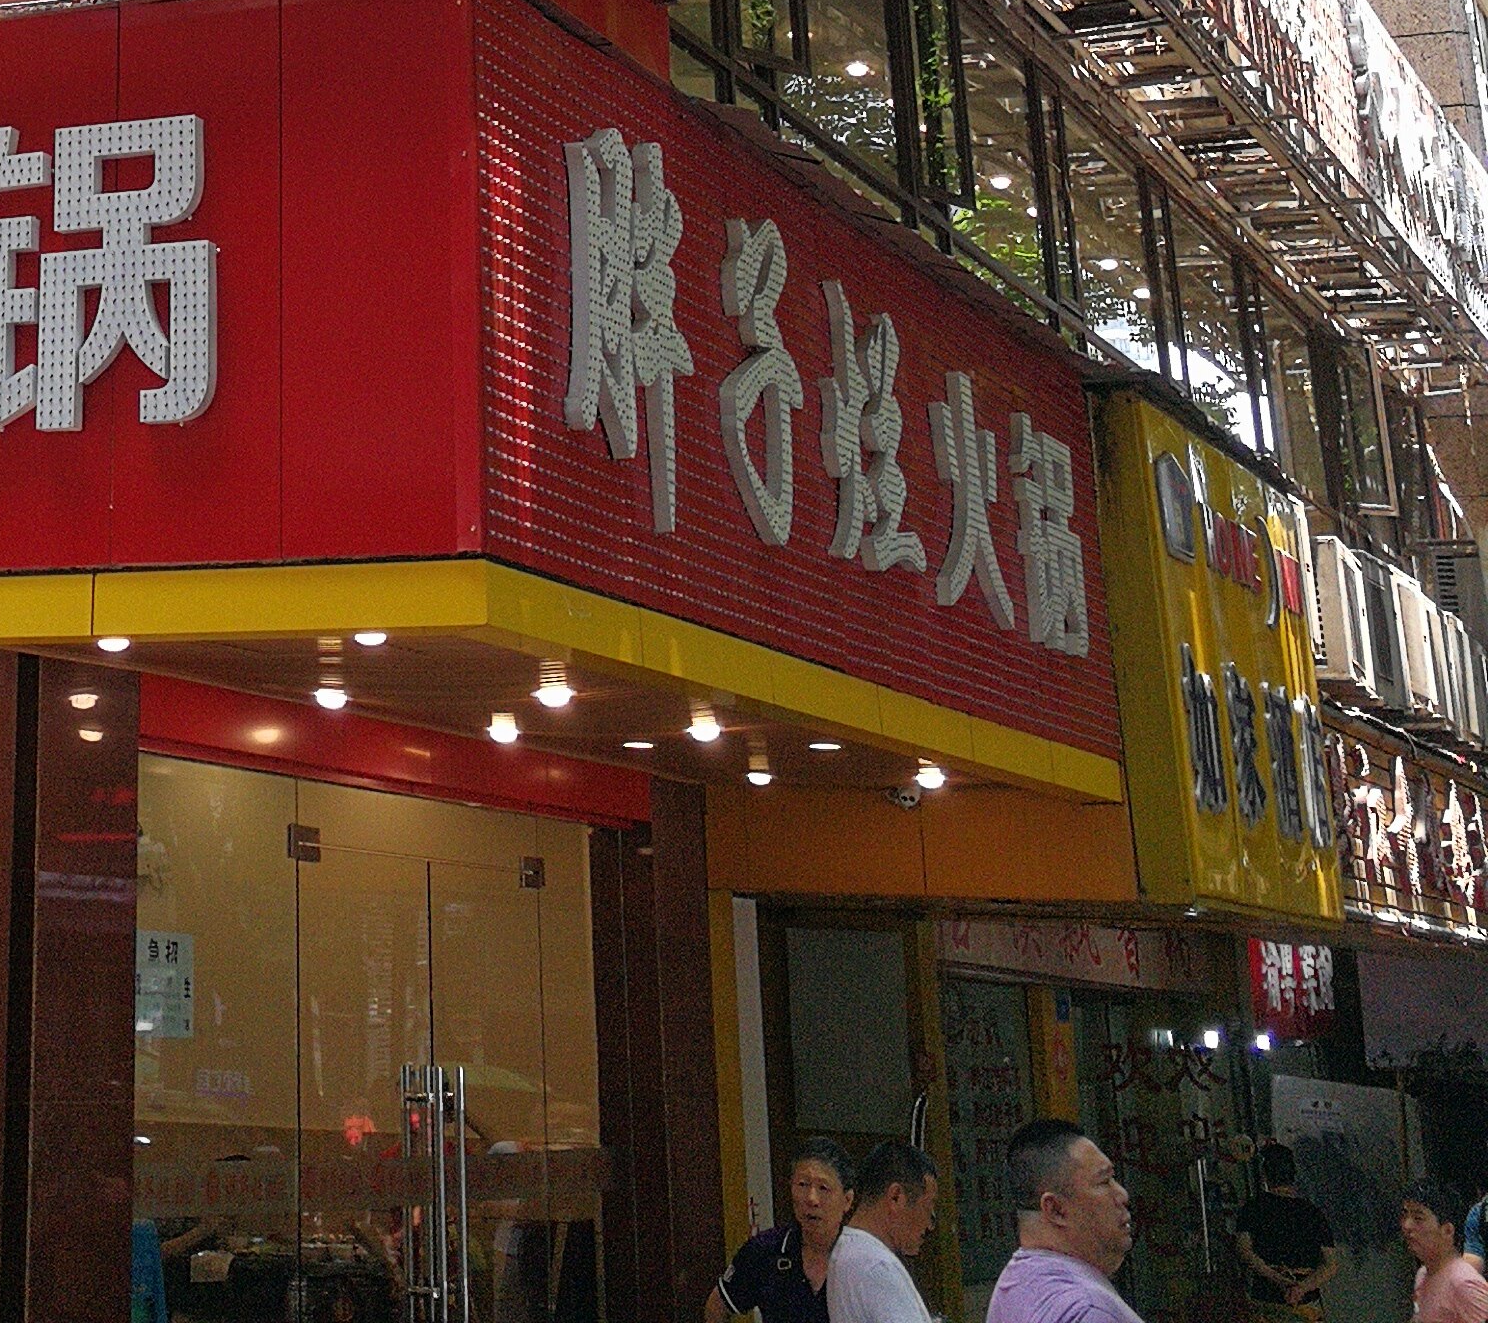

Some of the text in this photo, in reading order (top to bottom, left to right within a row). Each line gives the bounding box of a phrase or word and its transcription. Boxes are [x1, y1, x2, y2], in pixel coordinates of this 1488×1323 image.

[564, 128, 1090, 657] 胖子烂火锅
